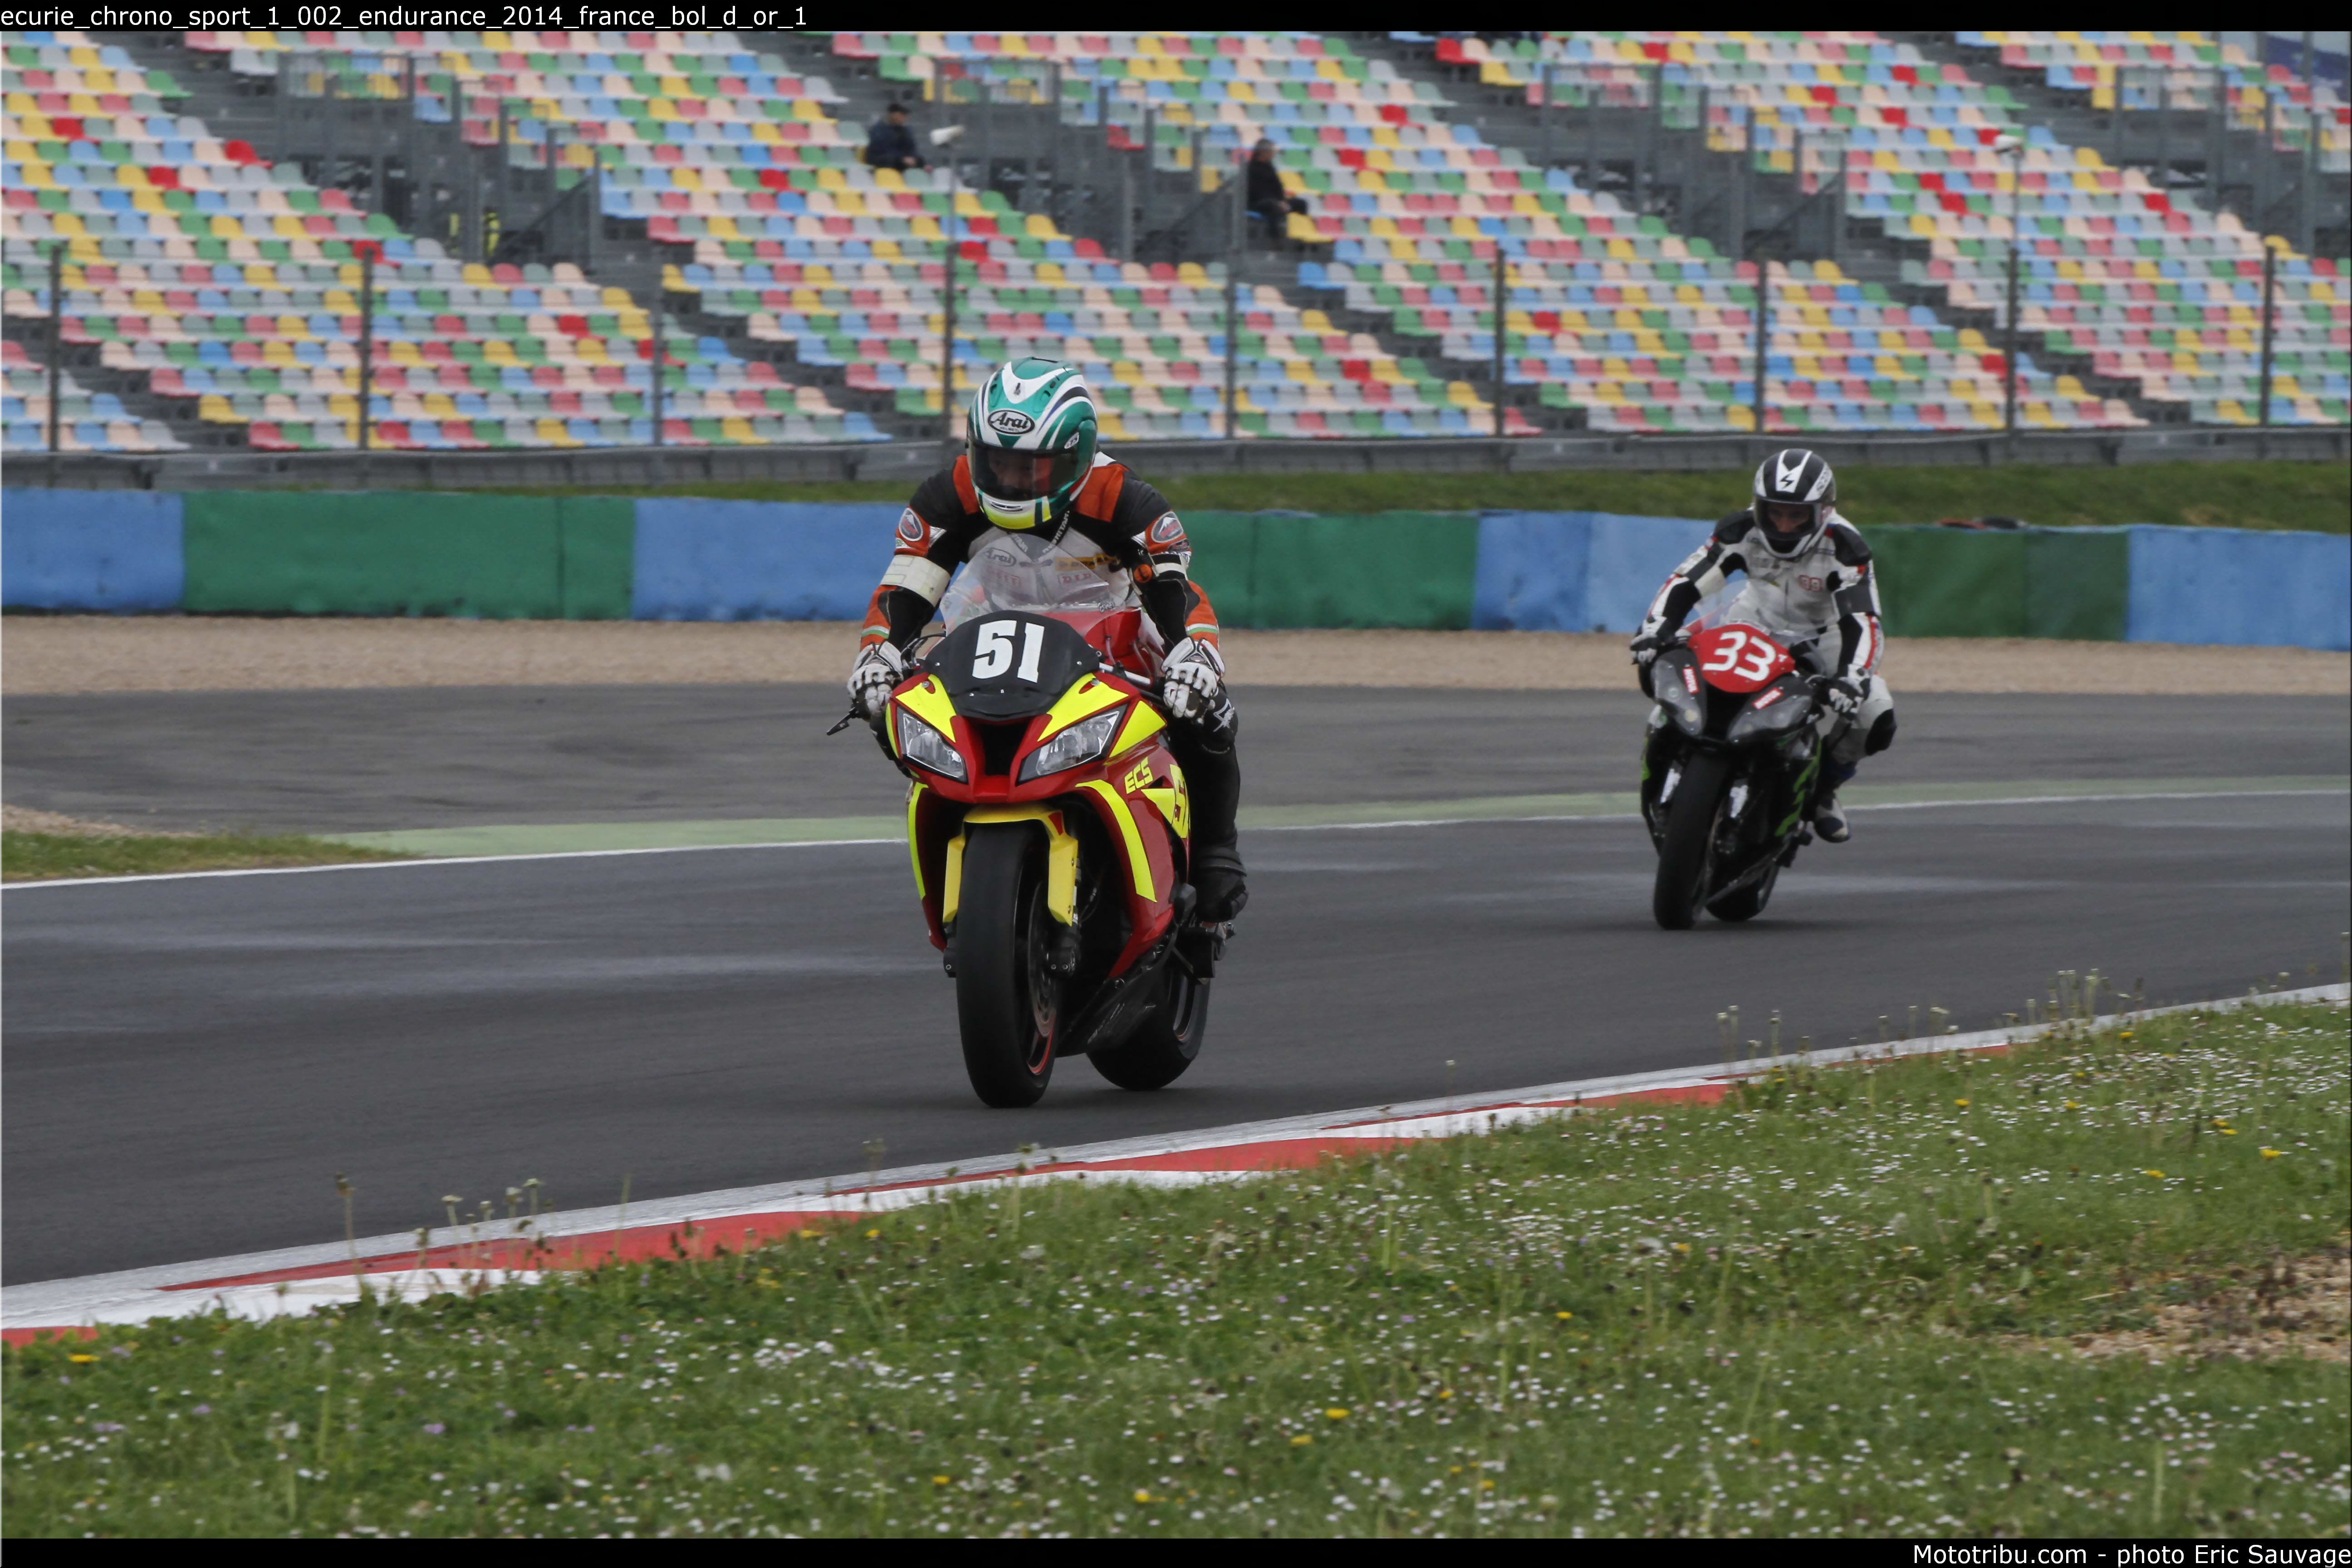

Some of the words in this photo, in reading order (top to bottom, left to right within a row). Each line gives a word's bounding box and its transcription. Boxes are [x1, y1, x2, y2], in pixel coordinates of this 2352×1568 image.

[992, 412, 1029, 429] Arai
[972, 620, 1044, 683] 51
[1702, 631, 1776, 681] 33
[1124, 756, 1153, 794] ECS
